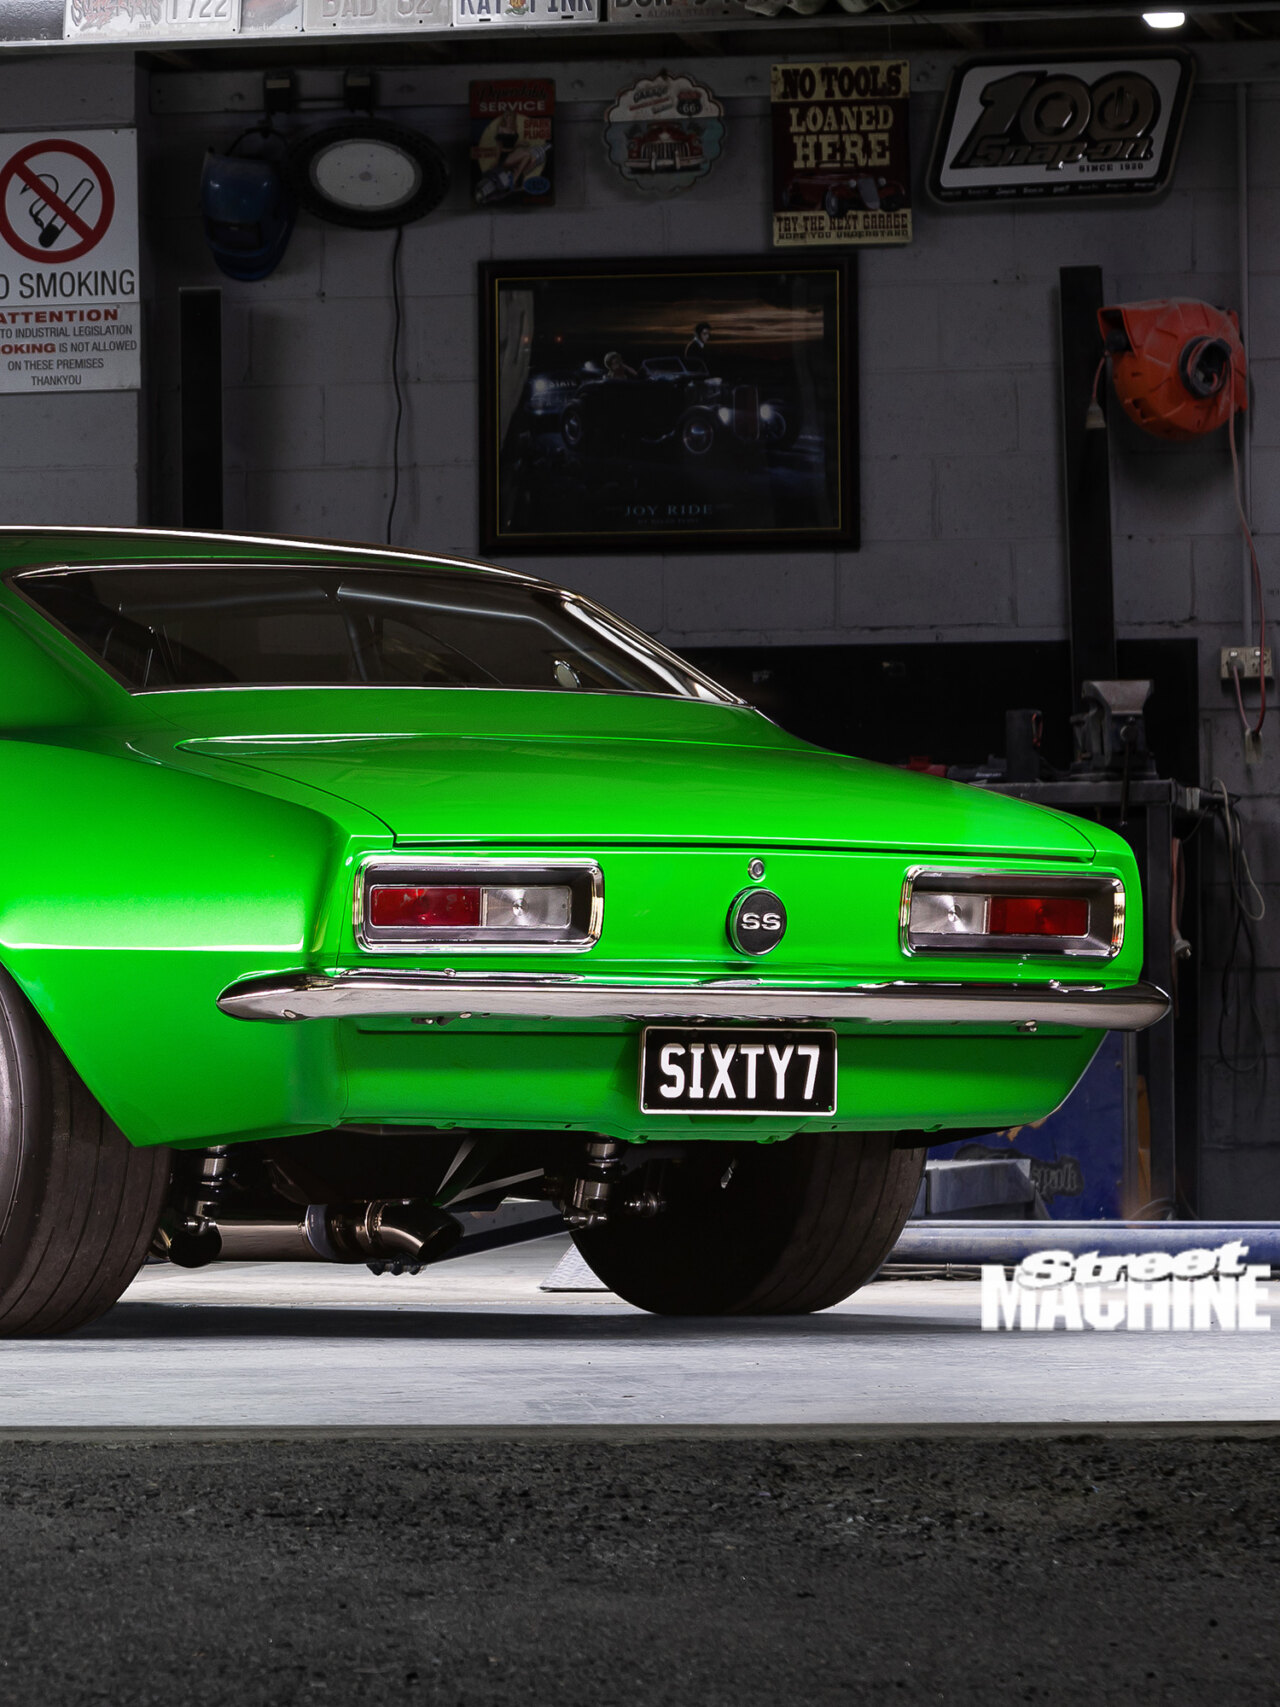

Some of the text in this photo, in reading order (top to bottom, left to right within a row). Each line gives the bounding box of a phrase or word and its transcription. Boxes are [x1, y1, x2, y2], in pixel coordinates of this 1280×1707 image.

[782, 64, 901, 99] NO TOOLS
[479, 100, 546, 113] SERVICE
[682, 104, 697, 113] 66
[789, 105, 894, 133] LOANED
[793, 133, 891, 169] HERE
[1079, 162, 1144, 173] SINCE 1920
[777, 213, 908, 232] TRY THE NEXT GARAGE
[811, 231, 832, 239] YOU
[836, 229, 909, 238] UNDERSTAND
[19, 269, 135, 299] SMOKING
[0, 328, 13, 339] TO
[15, 327, 70, 339] INDUSTRIAL
[73, 324, 133, 337] LEGISLATION
[59, 343, 68, 353] IS
[70, 341, 90, 353] NOT
[91, 340, 137, 352] ALLOWED
[7, 358, 104, 371] ON THESE PREMISES
[31, 375, 82, 386] THANKYOU
[624, 503, 713, 516] JOY RIDE
[741, 912, 781, 931] SS
[659, 1042, 820, 1100] SIXTY7
